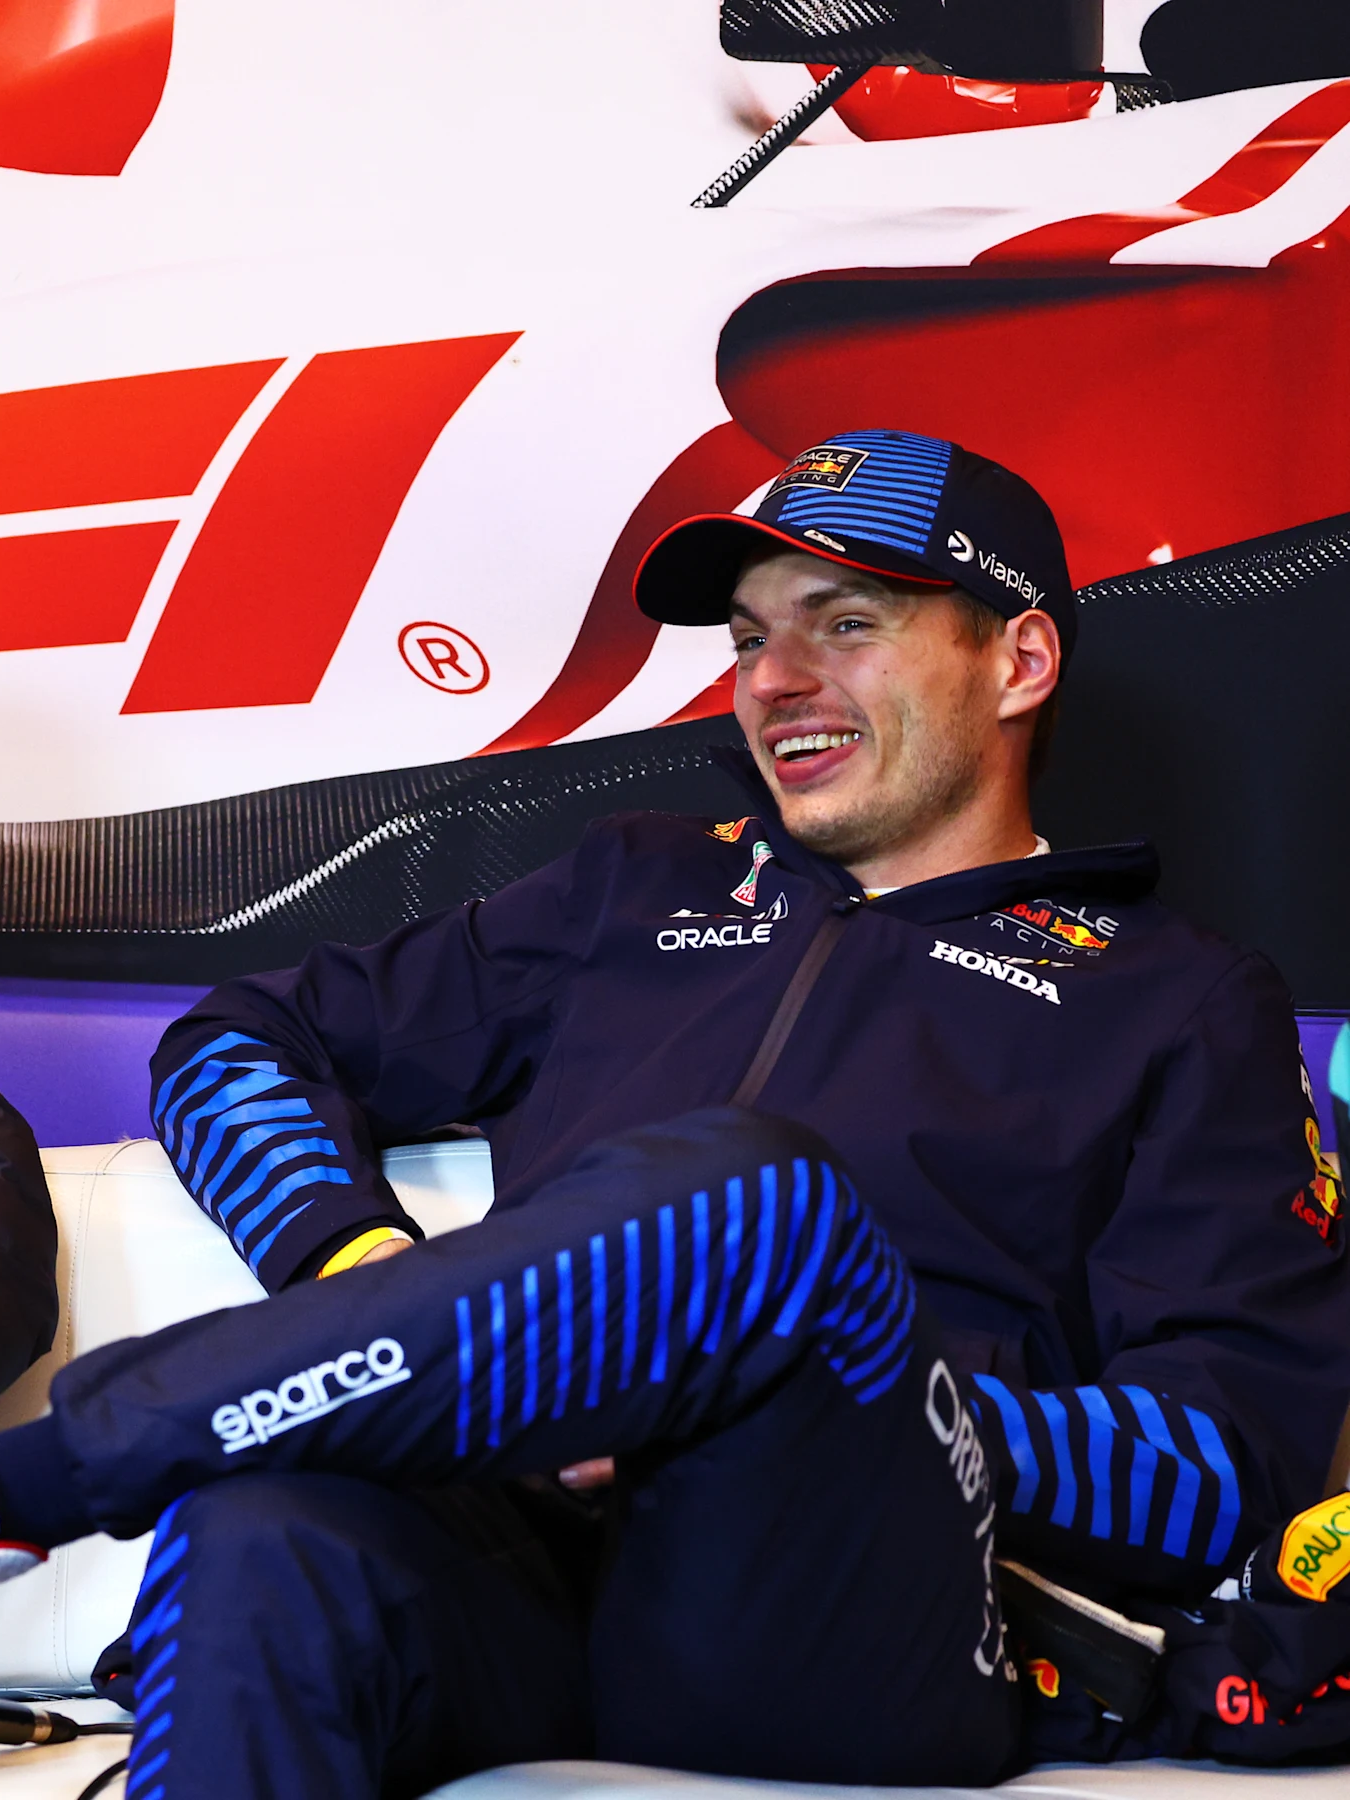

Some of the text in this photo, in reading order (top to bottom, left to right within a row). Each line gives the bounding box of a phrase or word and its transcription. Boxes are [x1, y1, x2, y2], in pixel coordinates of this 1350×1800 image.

[978, 550, 1046, 608] viaplay
[656, 923, 773, 951] ORACLE
[1011, 903, 1052, 928] Bull
[929, 940, 1061, 1005] HONDA
[211, 1337, 408, 1446] sparco
[1292, 1505, 1350, 1582] RAUC
